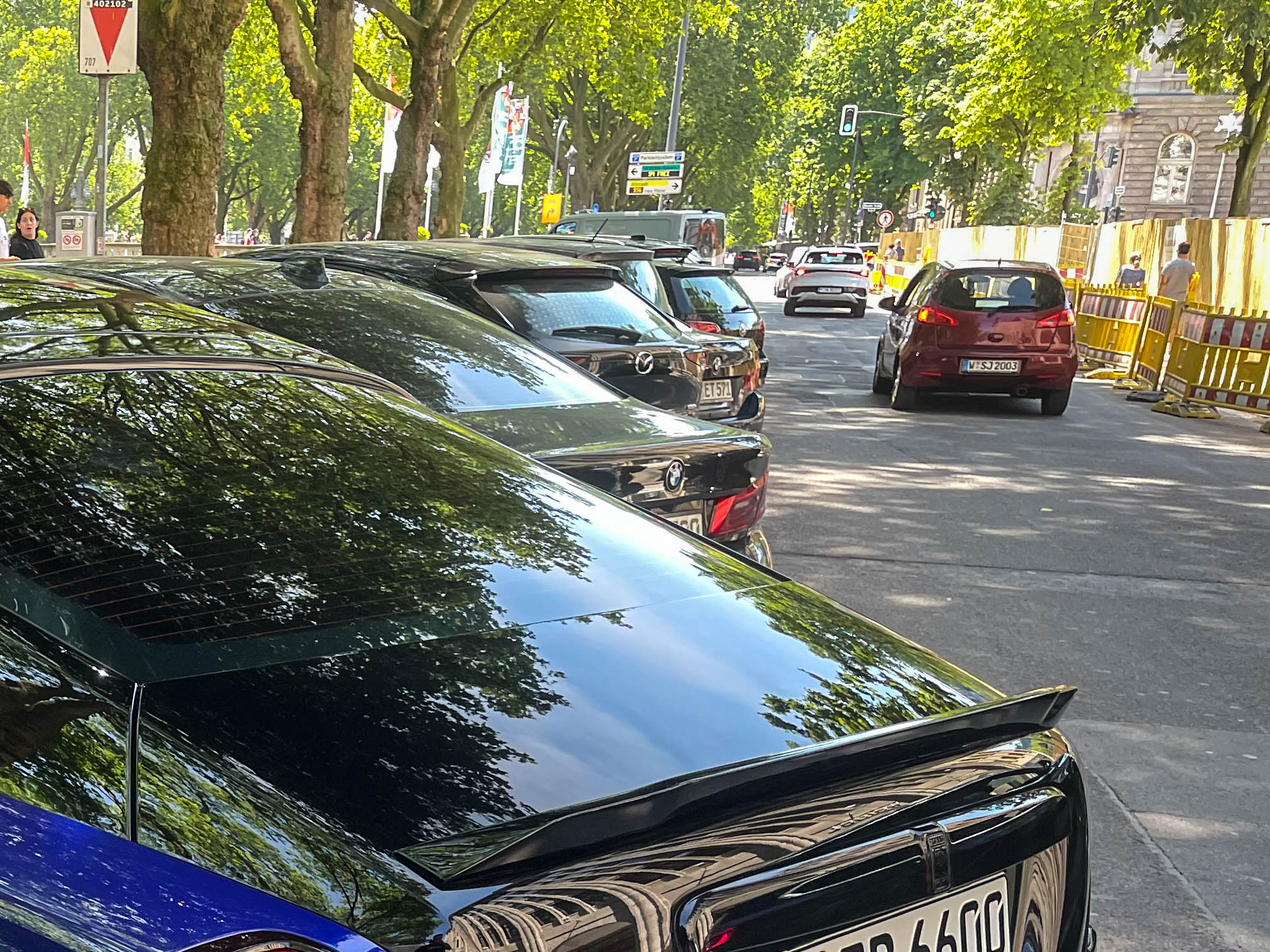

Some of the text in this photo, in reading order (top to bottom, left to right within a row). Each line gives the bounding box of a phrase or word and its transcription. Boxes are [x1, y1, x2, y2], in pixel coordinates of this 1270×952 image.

[85, 57, 96, 66] 707
[969, 361, 1018, 371] W SJ 2003
[704, 381, 731, 398] ET 571
